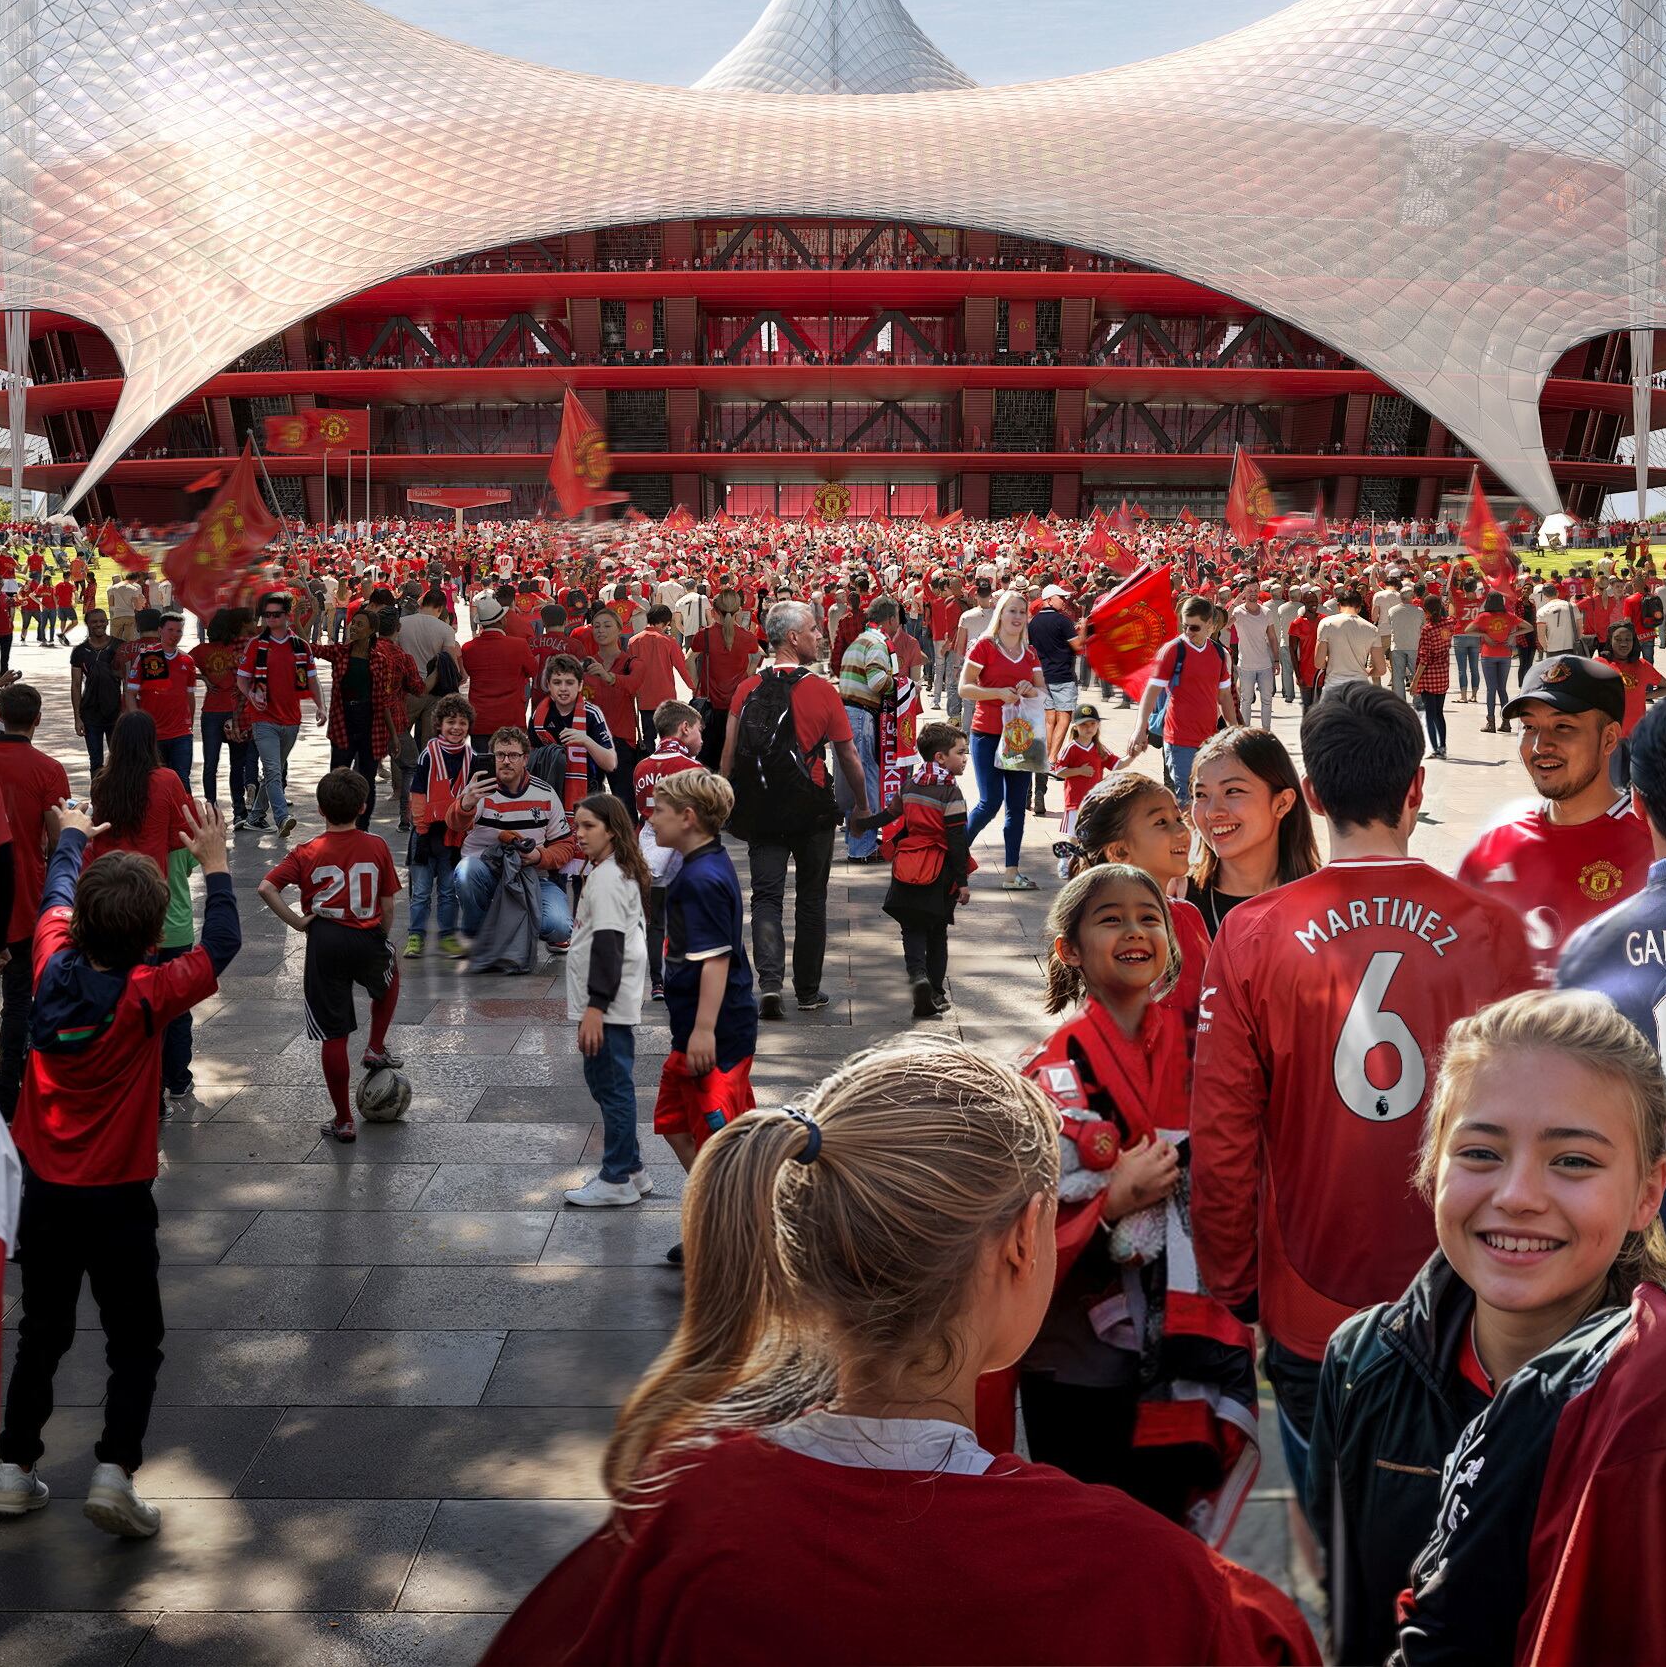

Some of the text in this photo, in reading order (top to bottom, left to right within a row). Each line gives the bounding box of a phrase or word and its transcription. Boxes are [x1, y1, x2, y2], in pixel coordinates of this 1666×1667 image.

[685, 600, 693, 616] 7
[1552, 608, 1561, 628] 7
[310, 862, 380, 919] 20
[1293, 896, 1459, 956] MARTINEZ
[1333, 950, 1426, 1122] 6
